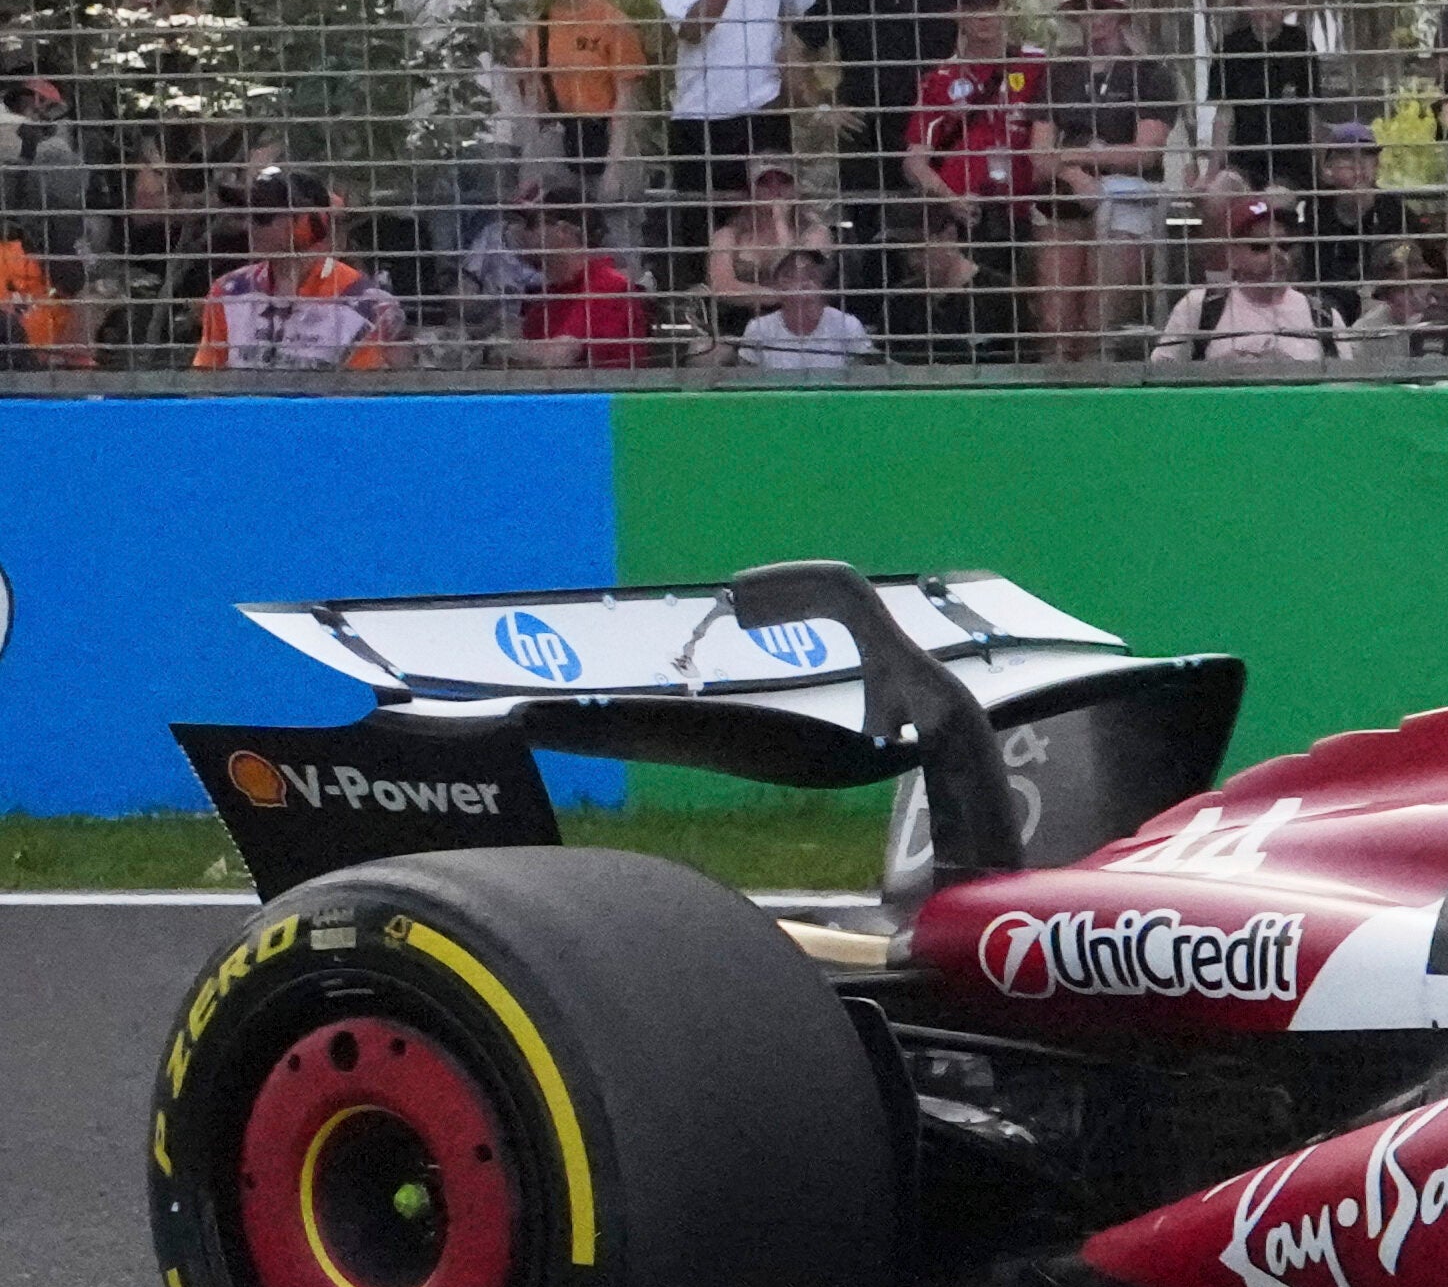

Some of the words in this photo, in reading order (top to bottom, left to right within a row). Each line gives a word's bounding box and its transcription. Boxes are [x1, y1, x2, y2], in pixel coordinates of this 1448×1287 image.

[496, 611, 582, 682] hp
[288, 763, 501, 817] V-Power
[1053, 912, 1298, 997] UniCredit
